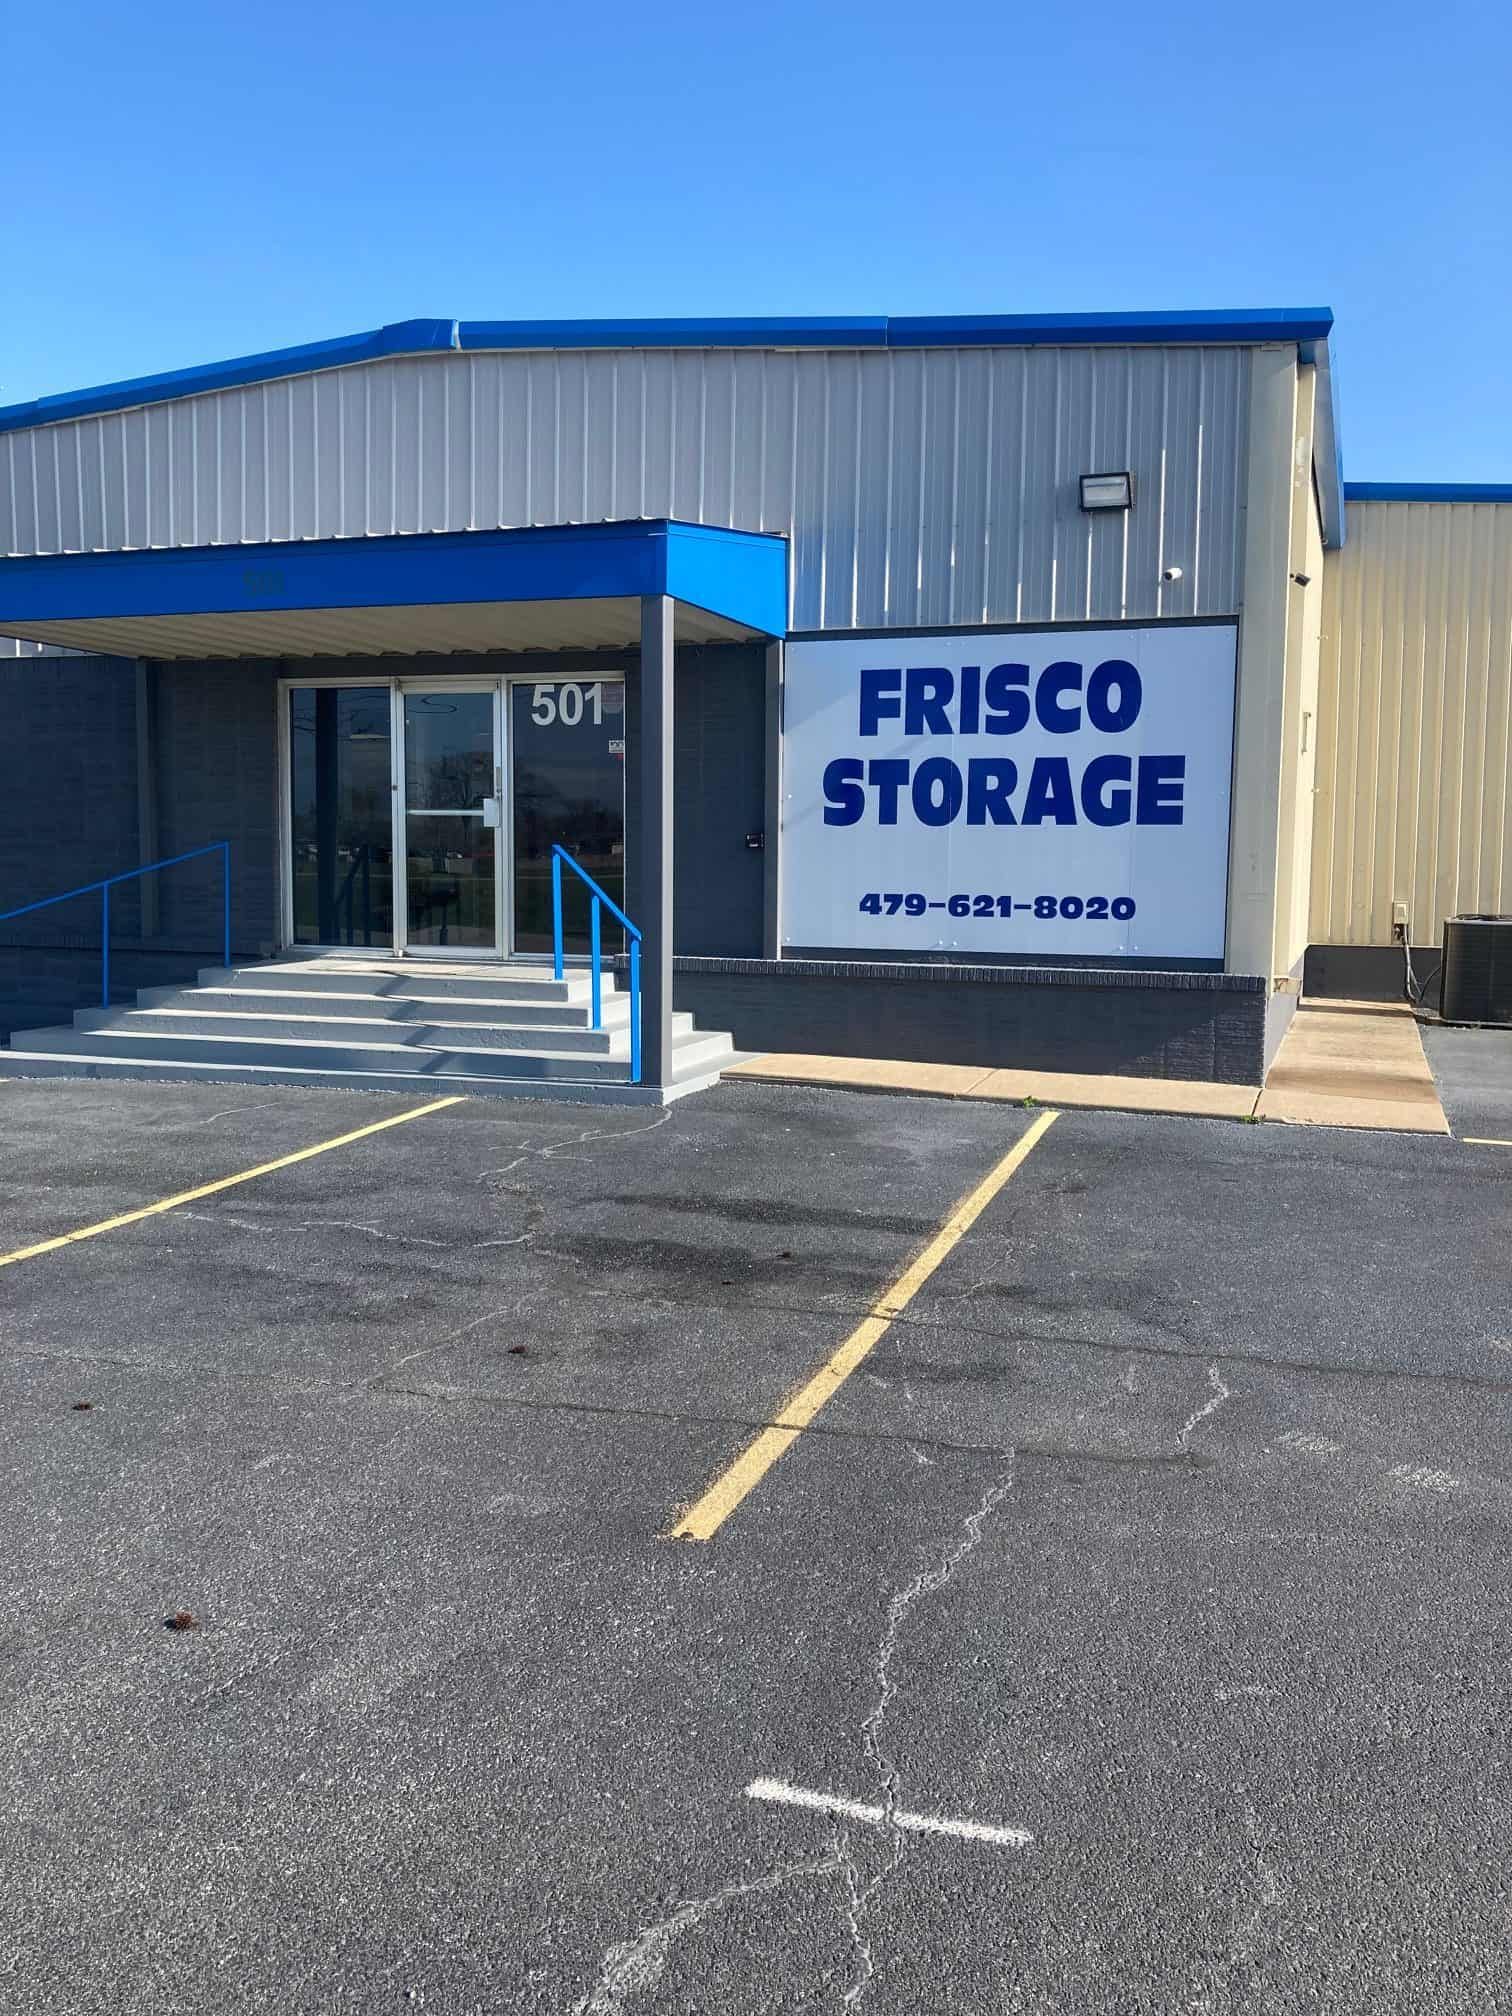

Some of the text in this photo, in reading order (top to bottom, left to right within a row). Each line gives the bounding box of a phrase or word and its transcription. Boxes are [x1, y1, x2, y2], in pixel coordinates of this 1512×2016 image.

[531, 683, 602, 726] 501
[859, 659, 1142, 737] FRISCO
[823, 754, 1186, 827] STORAGE
[859, 893, 1137, 921] 479-621-8020
